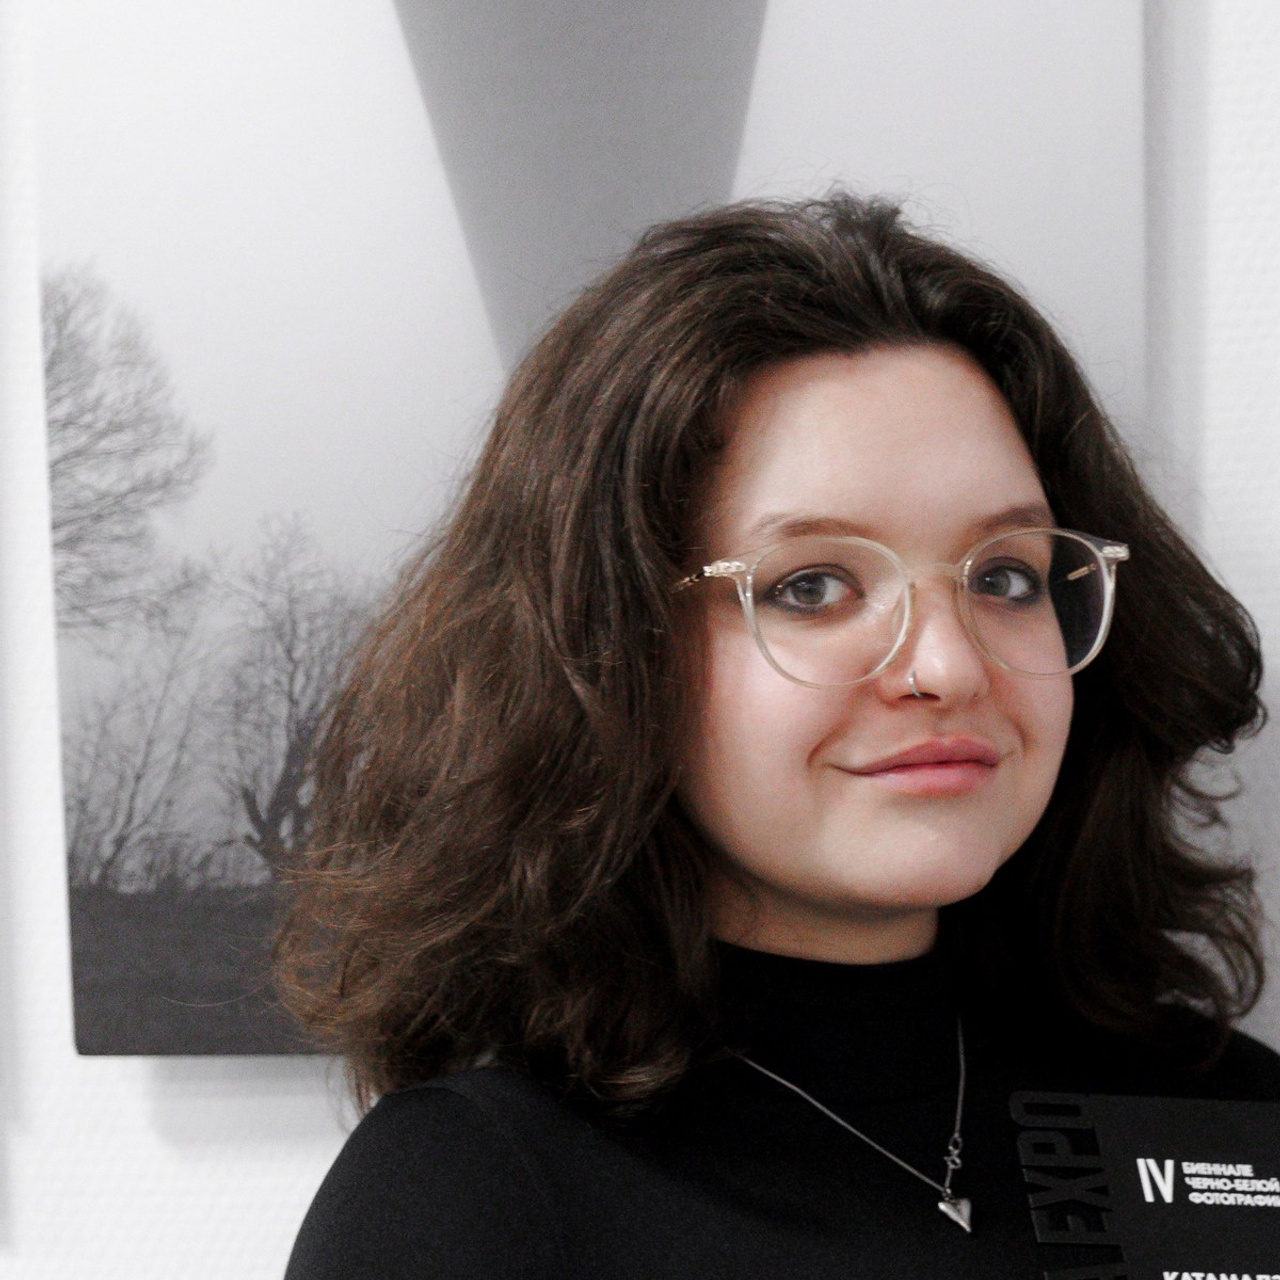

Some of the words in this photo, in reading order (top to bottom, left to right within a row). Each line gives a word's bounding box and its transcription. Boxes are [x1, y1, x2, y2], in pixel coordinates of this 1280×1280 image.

[1009, 1090, 1119, 1246] EXPO
[1136, 1158, 1174, 1203] IV
[1181, 1162, 1254, 1177] БИЕННАЛЕ
[1184, 1177, 1280, 1192] ЧЕРНО-БЕЛОЙ
